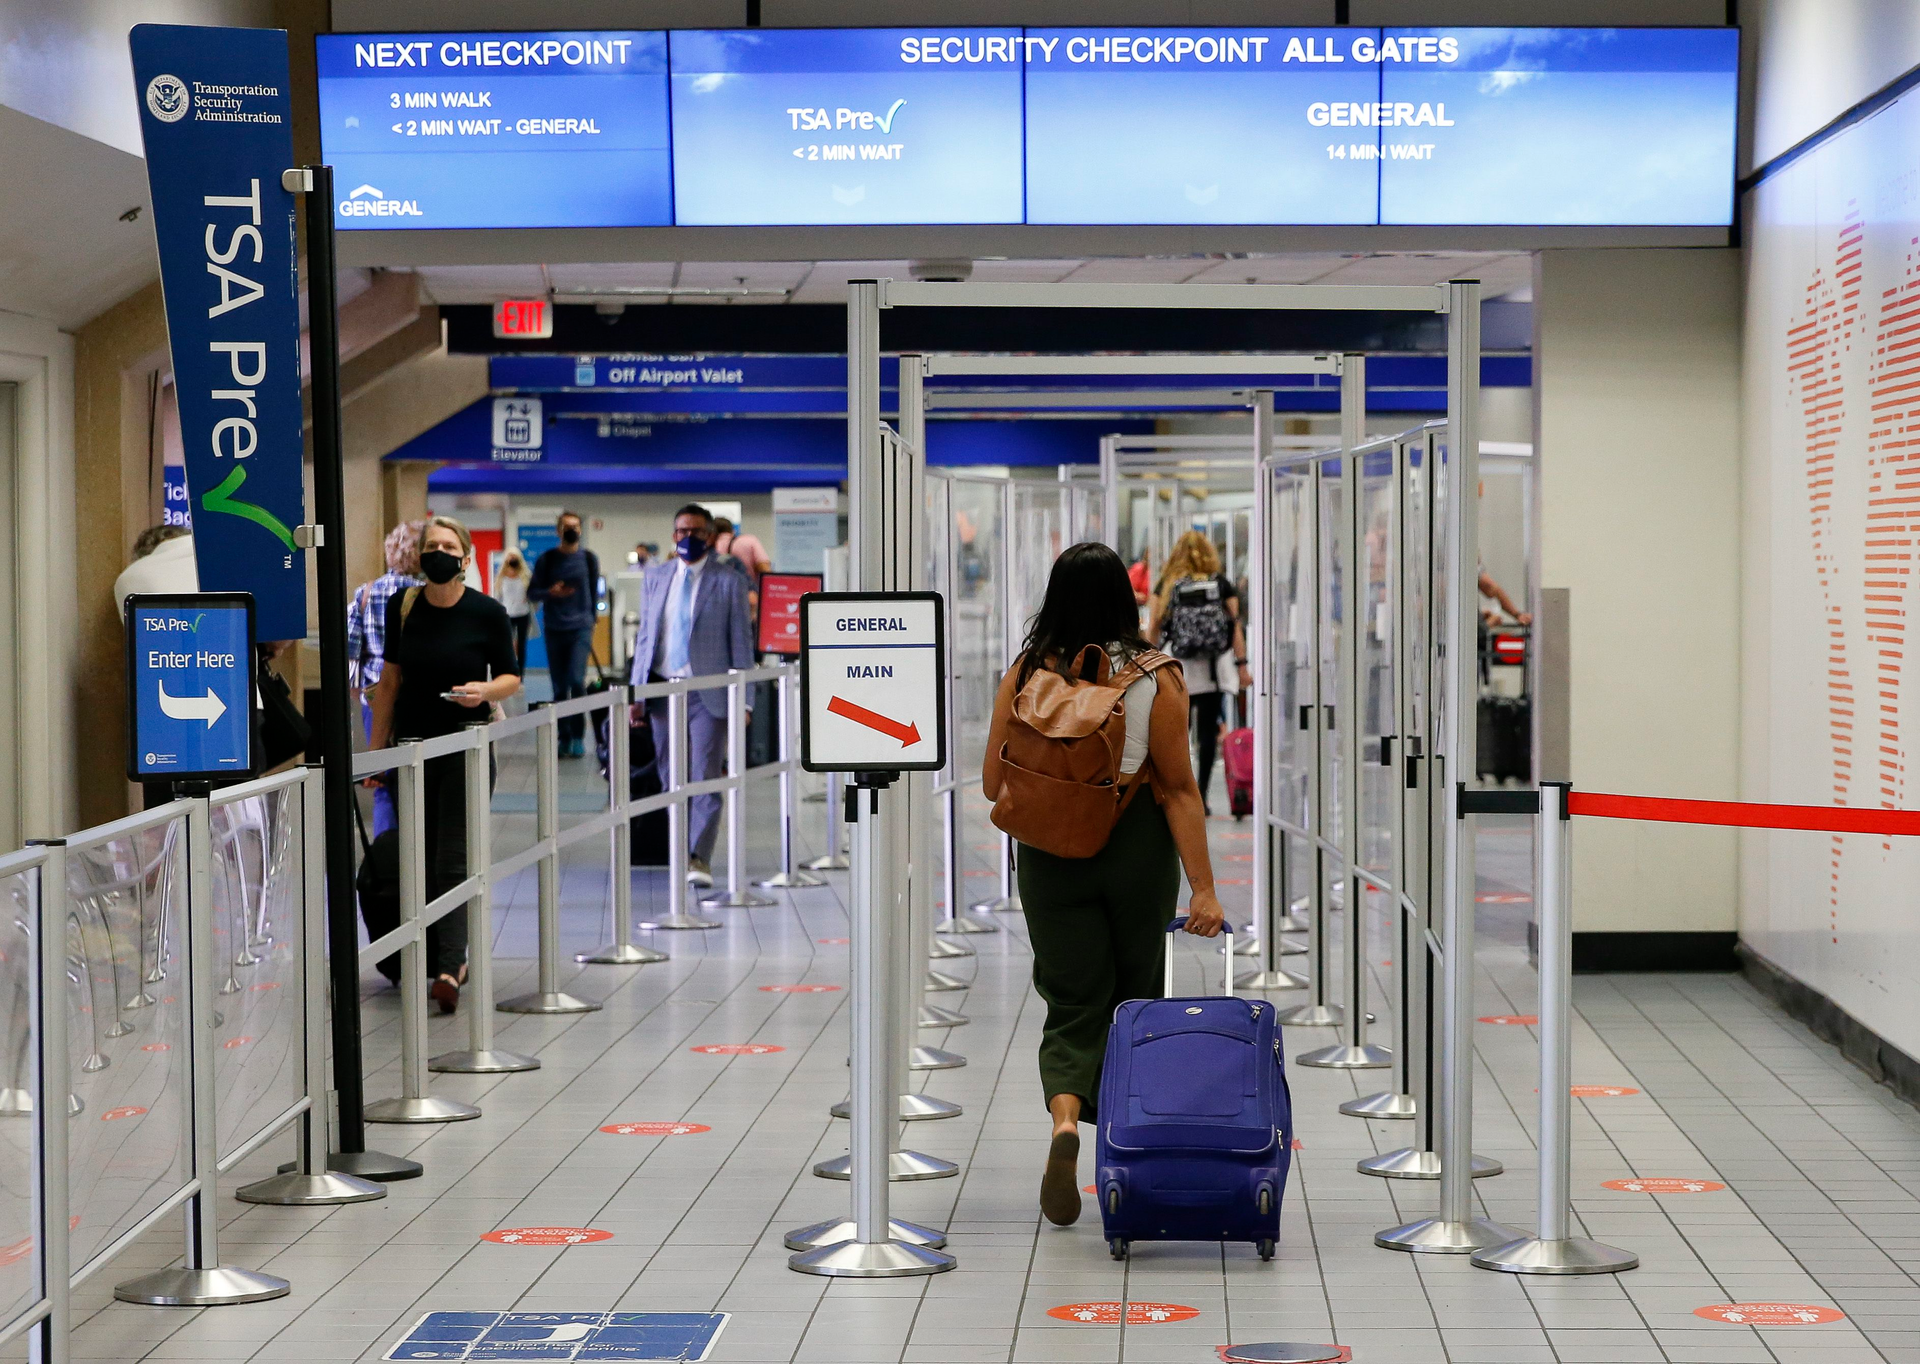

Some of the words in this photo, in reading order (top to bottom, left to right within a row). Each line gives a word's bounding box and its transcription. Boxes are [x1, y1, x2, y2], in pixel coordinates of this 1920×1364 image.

[354, 42, 432, 68] NEXT
[440, 40, 632, 67] CHECKPOINT
[900, 37, 1059, 63] SECURITY
[1066, 37, 1269, 63] CHECKPOINT
[1282, 37, 1344, 63] ALL
[1351, 37, 1459, 63] GATES
[193, 81, 278, 97] Transportation
[194, 95, 243, 111] Security
[390, 92, 400, 108] 3
[405, 92, 437, 108] MIN
[441, 91, 491, 107] WALK
[195, 109, 282, 123] Administration
[787, 108, 831, 130] TSA
[836, 108, 874, 130] Pre
[1306, 102, 1455, 127] GENERAL
[391, 122, 403, 135] <
[407, 120, 418, 136] 2
[421, 120, 455, 136] MIN
[458, 119, 501, 135] WAIT
[516, 118, 600, 134] GENERAL
[793, 147, 804, 158] <
[808, 145, 819, 161] 2
[823, 145, 856, 161] MIN
[859, 144, 904, 160] WAIT
[1326, 144, 1346, 160] 14
[1350, 144, 1385, 160] MIN
[1390, 144, 1435, 160] WAIT
[339, 200, 423, 217] GENERAL
[204, 178, 265, 320] TSA
[503, 301, 546, 334] EXIT
[608, 367, 637, 383] Off
[639, 367, 698, 386] Airport
[700, 367, 744, 383] Valet
[209, 342, 267, 459] Pre
[491, 448, 542, 462] Elevator
[284, 554, 292, 569] TM
[144, 618, 166, 631] TSA
[169, 618, 188, 631] Pre
[836, 618, 907, 632] GENERAL
[148, 651, 192, 668] Enter
[196, 651, 235, 668] Here
[847, 665, 893, 679] MAIN
